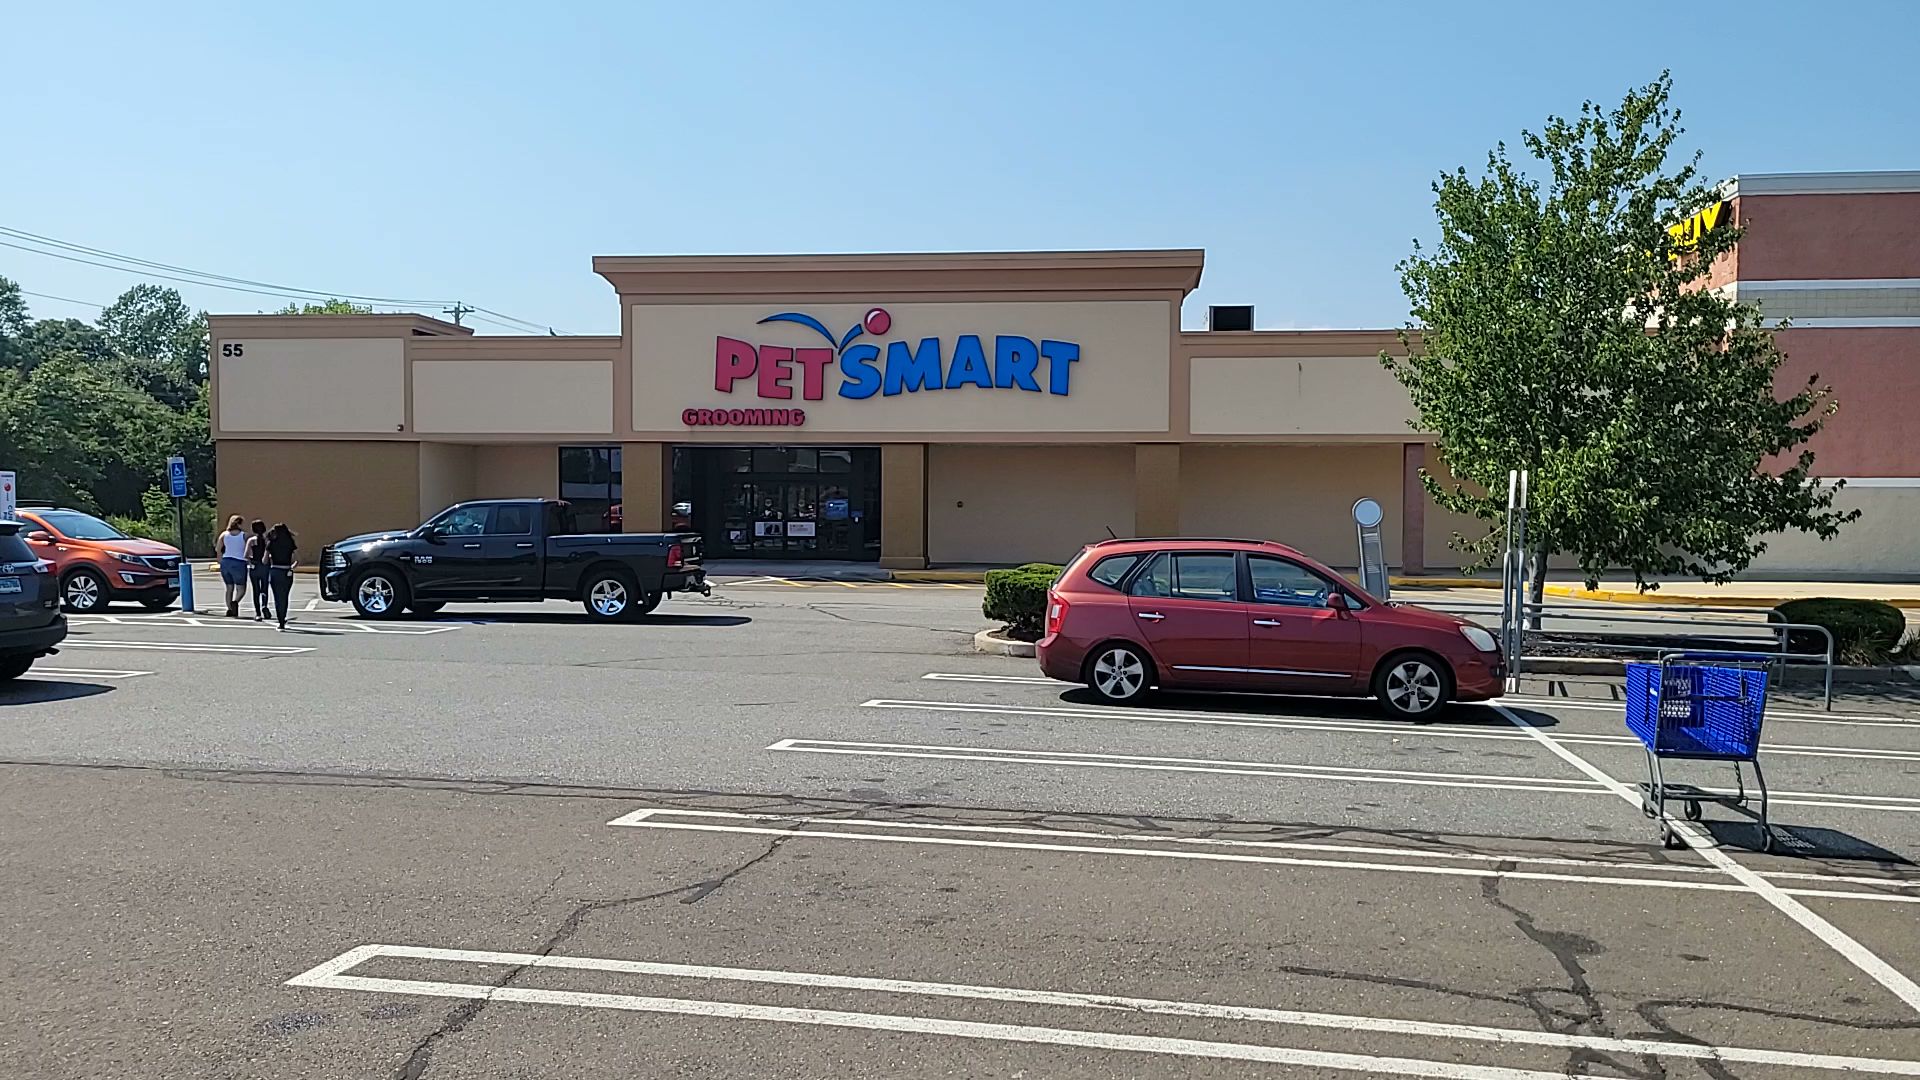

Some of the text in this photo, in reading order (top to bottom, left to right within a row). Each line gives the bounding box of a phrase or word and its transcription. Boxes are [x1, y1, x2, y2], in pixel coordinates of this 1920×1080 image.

[222, 343, 244, 358] 55
[714, 335, 1081, 401] PETSMART
[682, 408, 806, 426] GROOMING
